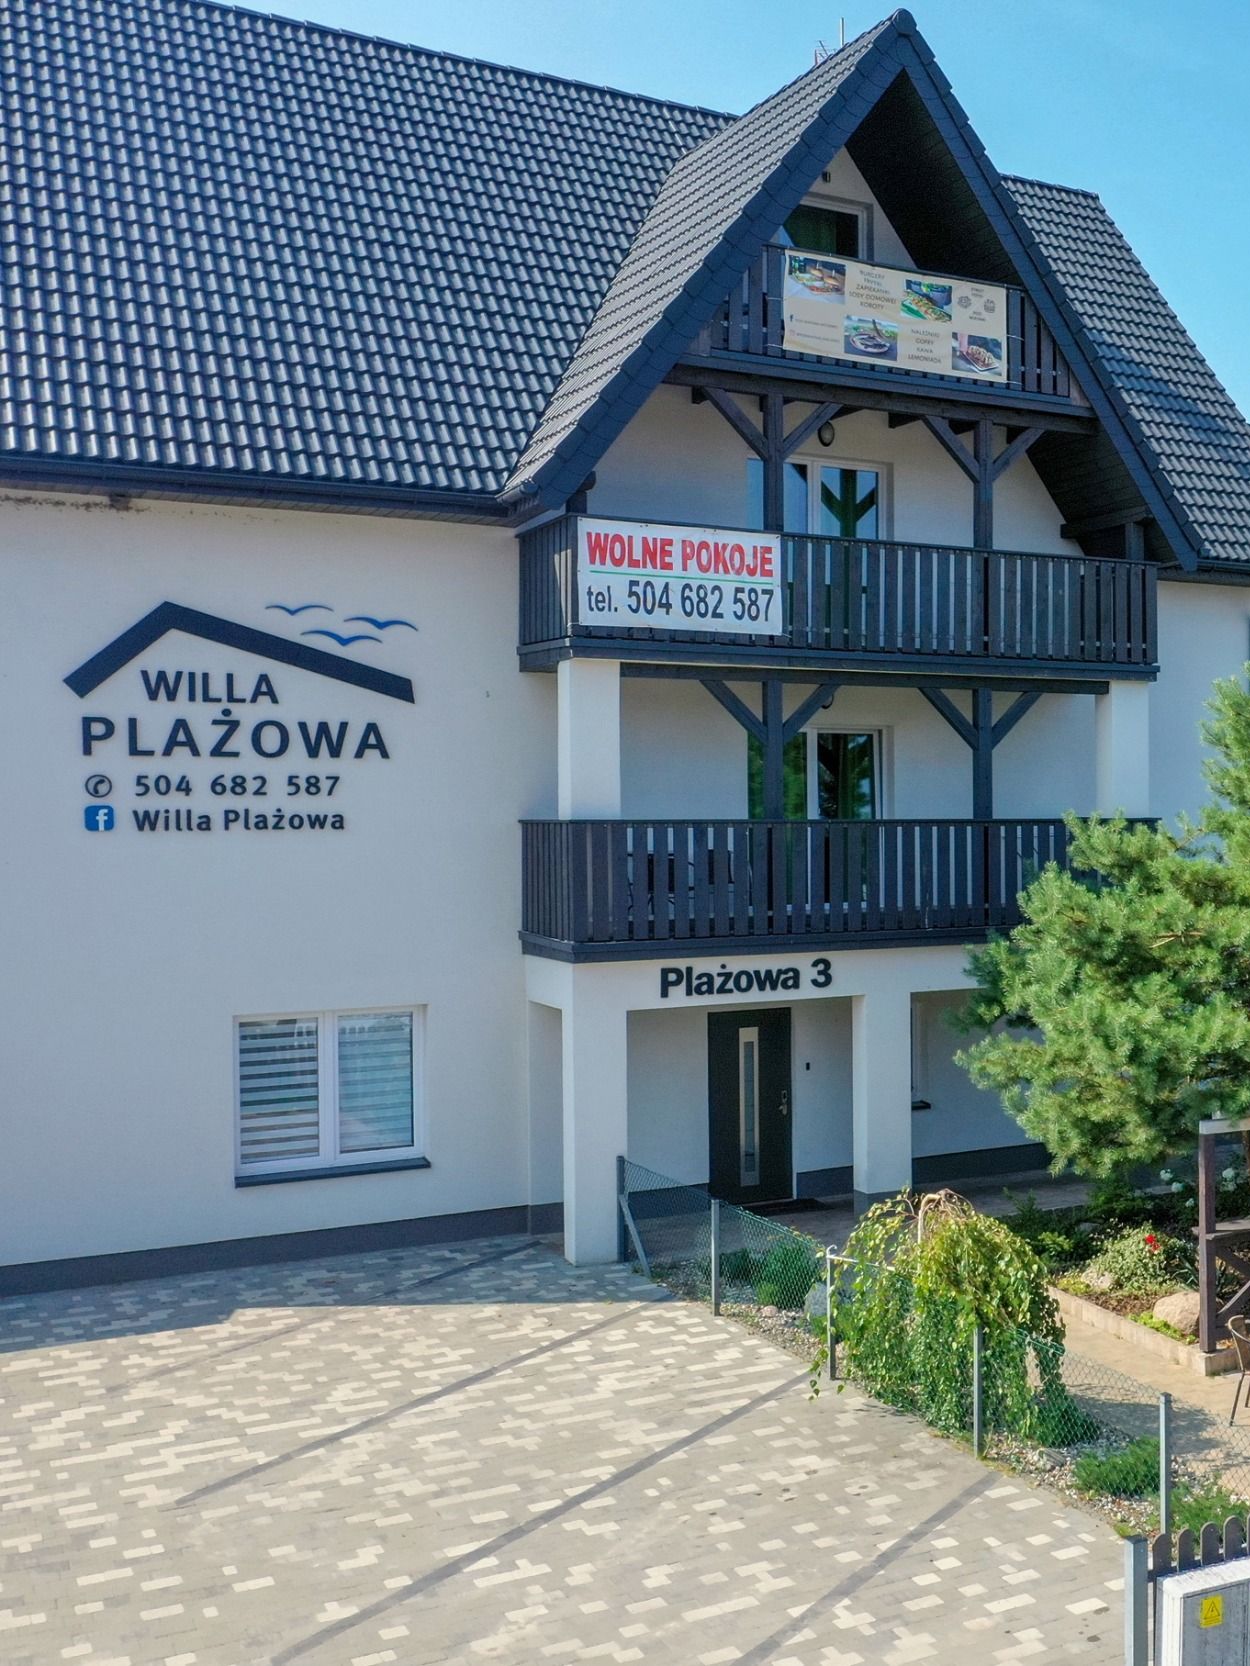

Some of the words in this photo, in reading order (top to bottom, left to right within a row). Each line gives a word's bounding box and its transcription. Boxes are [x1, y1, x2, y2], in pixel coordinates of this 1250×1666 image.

[586, 532, 674, 571] WOLNE
[681, 539, 774, 578] POKOJE
[586, 585, 618, 613] tel.
[627, 580, 673, 615] 504
[680, 583, 725, 619] 682
[732, 586, 775, 622] 587
[141, 669, 280, 705] WILLA
[81, 707, 390, 760] PLAŻOWA
[135, 774, 193, 797] 504
[210, 774, 268, 797] 682
[286, 775, 341, 797] 587
[132, 809, 212, 832] Willa
[223, 807, 345, 831] Plażowa
[660, 963, 801, 999] Plażowa
[810, 957, 833, 988] 3
